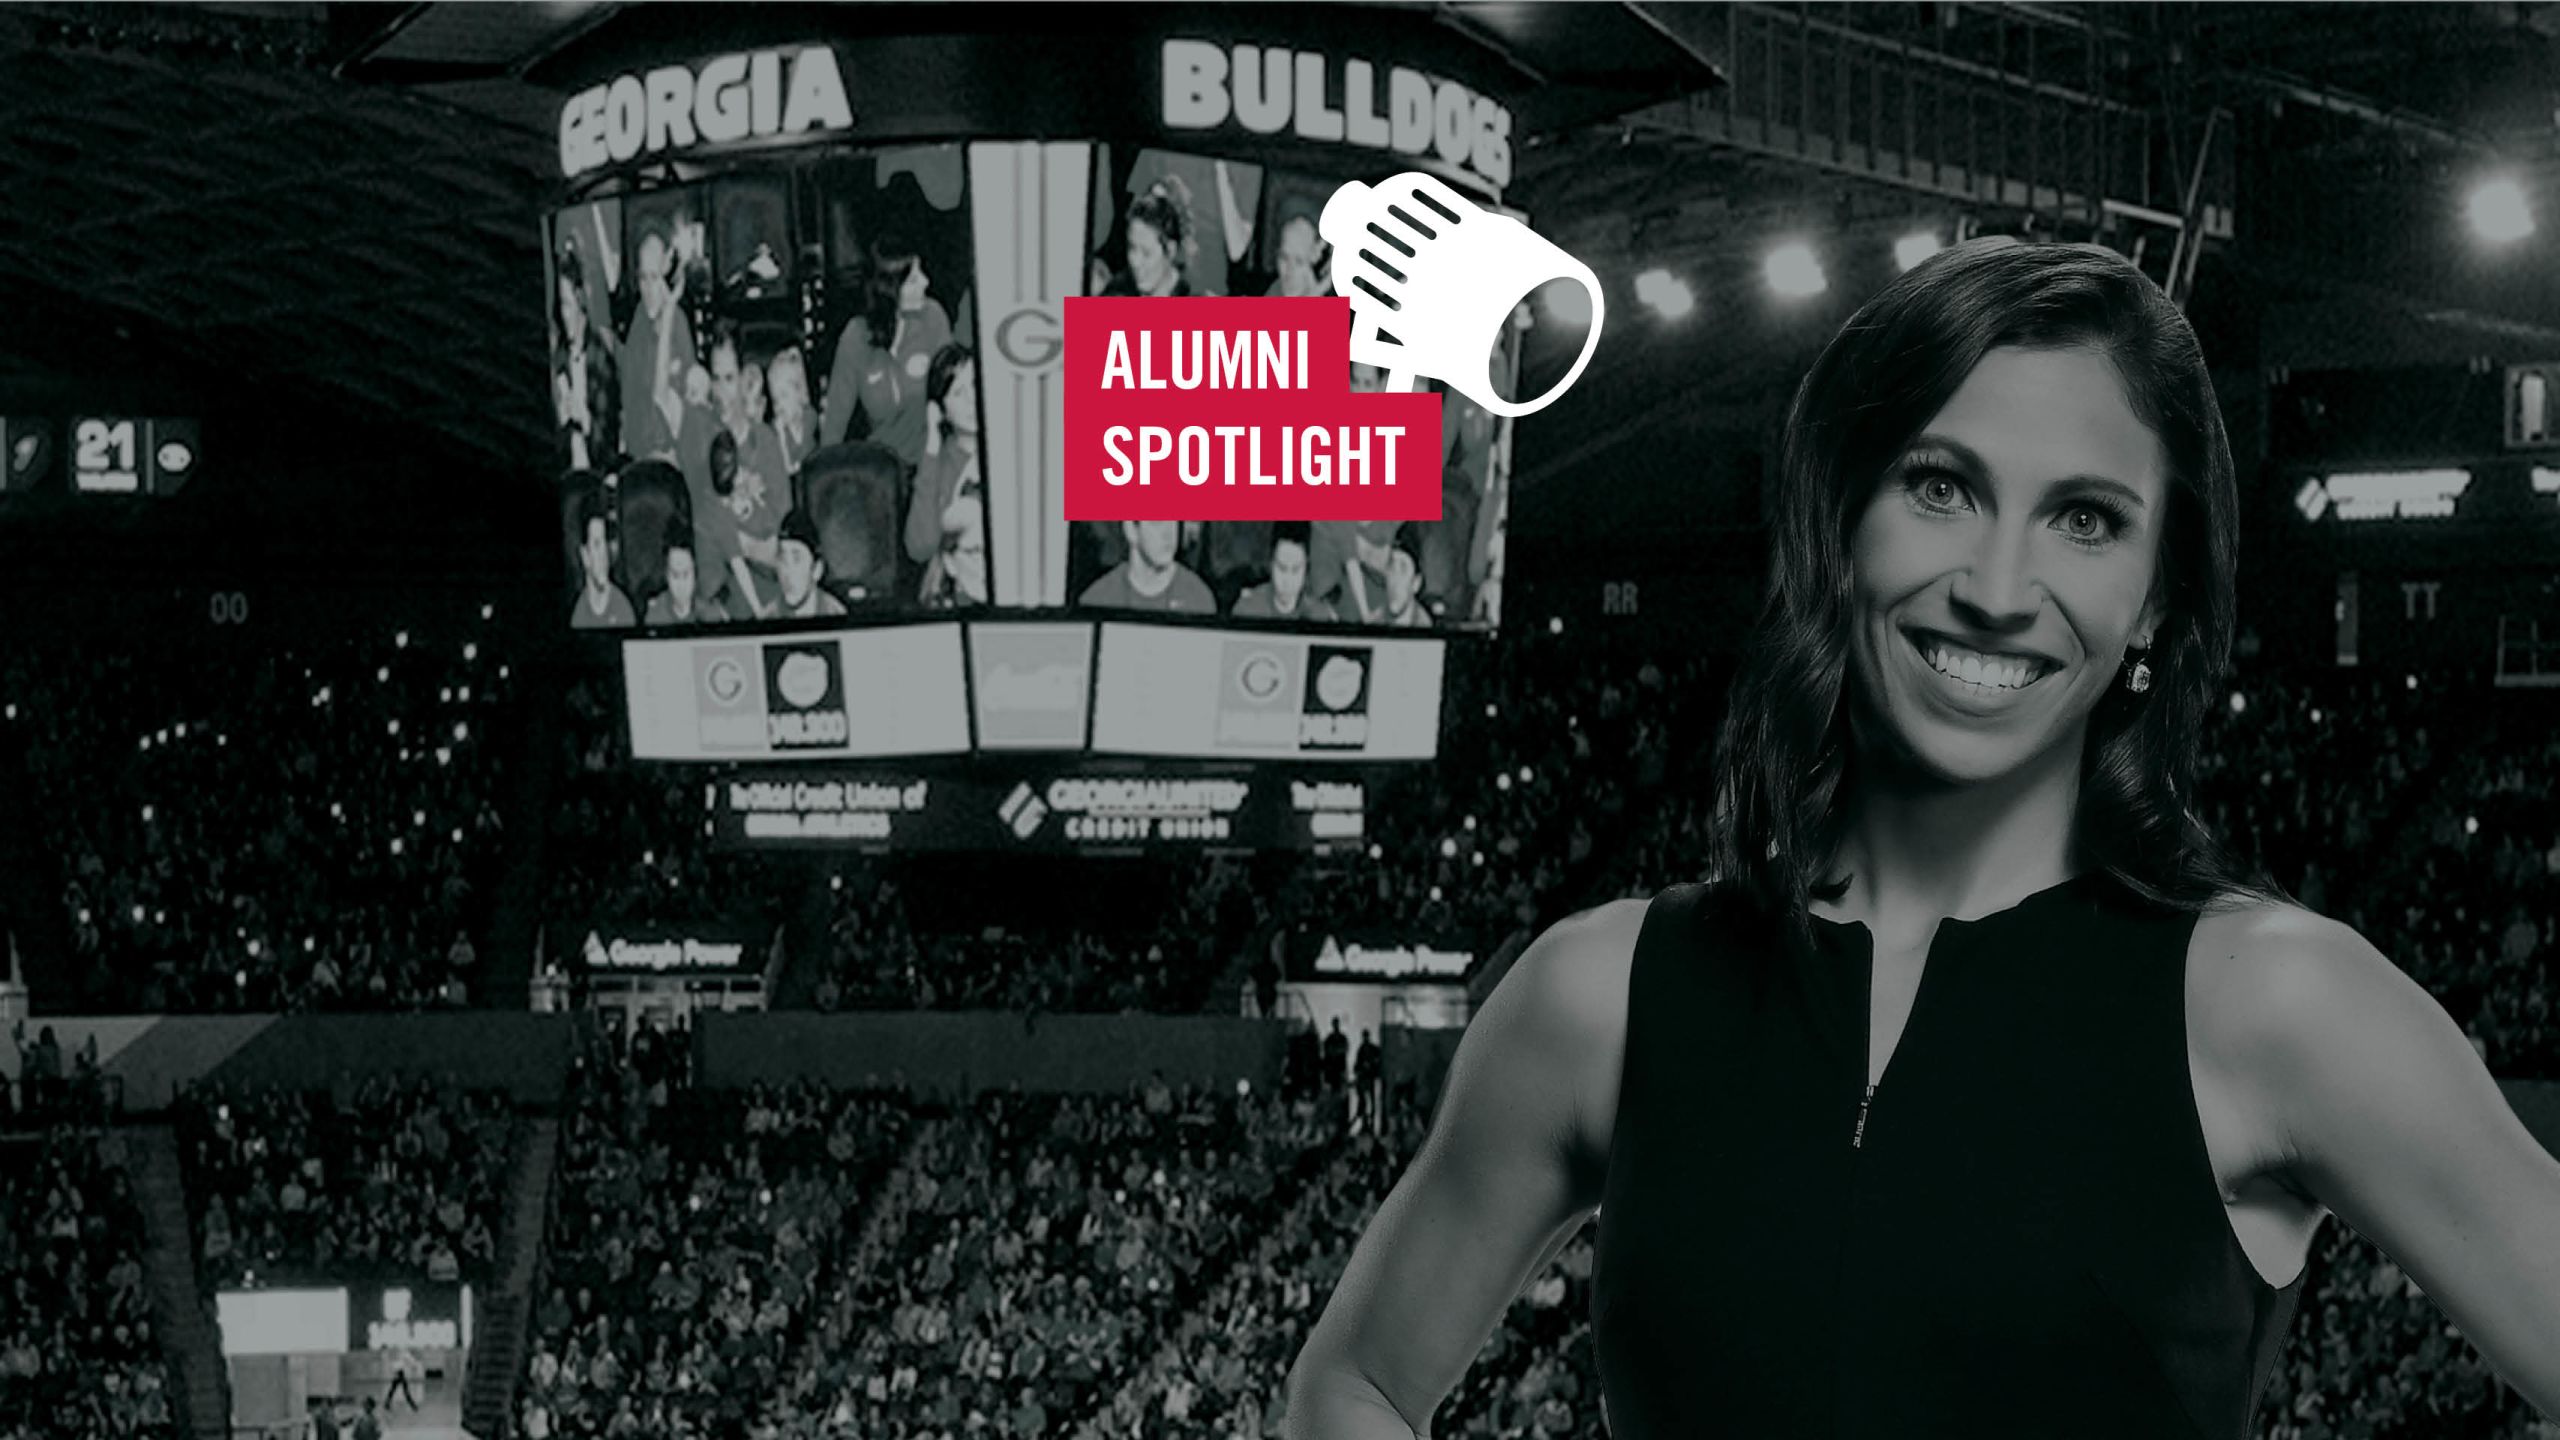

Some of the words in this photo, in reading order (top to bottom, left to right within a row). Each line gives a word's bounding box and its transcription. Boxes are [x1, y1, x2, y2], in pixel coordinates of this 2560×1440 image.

[559, 44, 854, 178] GEORGIA
[1161, 38, 1513, 189] BULLDOGS
[76, 418, 136, 471] 21
[1603, 581, 1638, 615] RR
